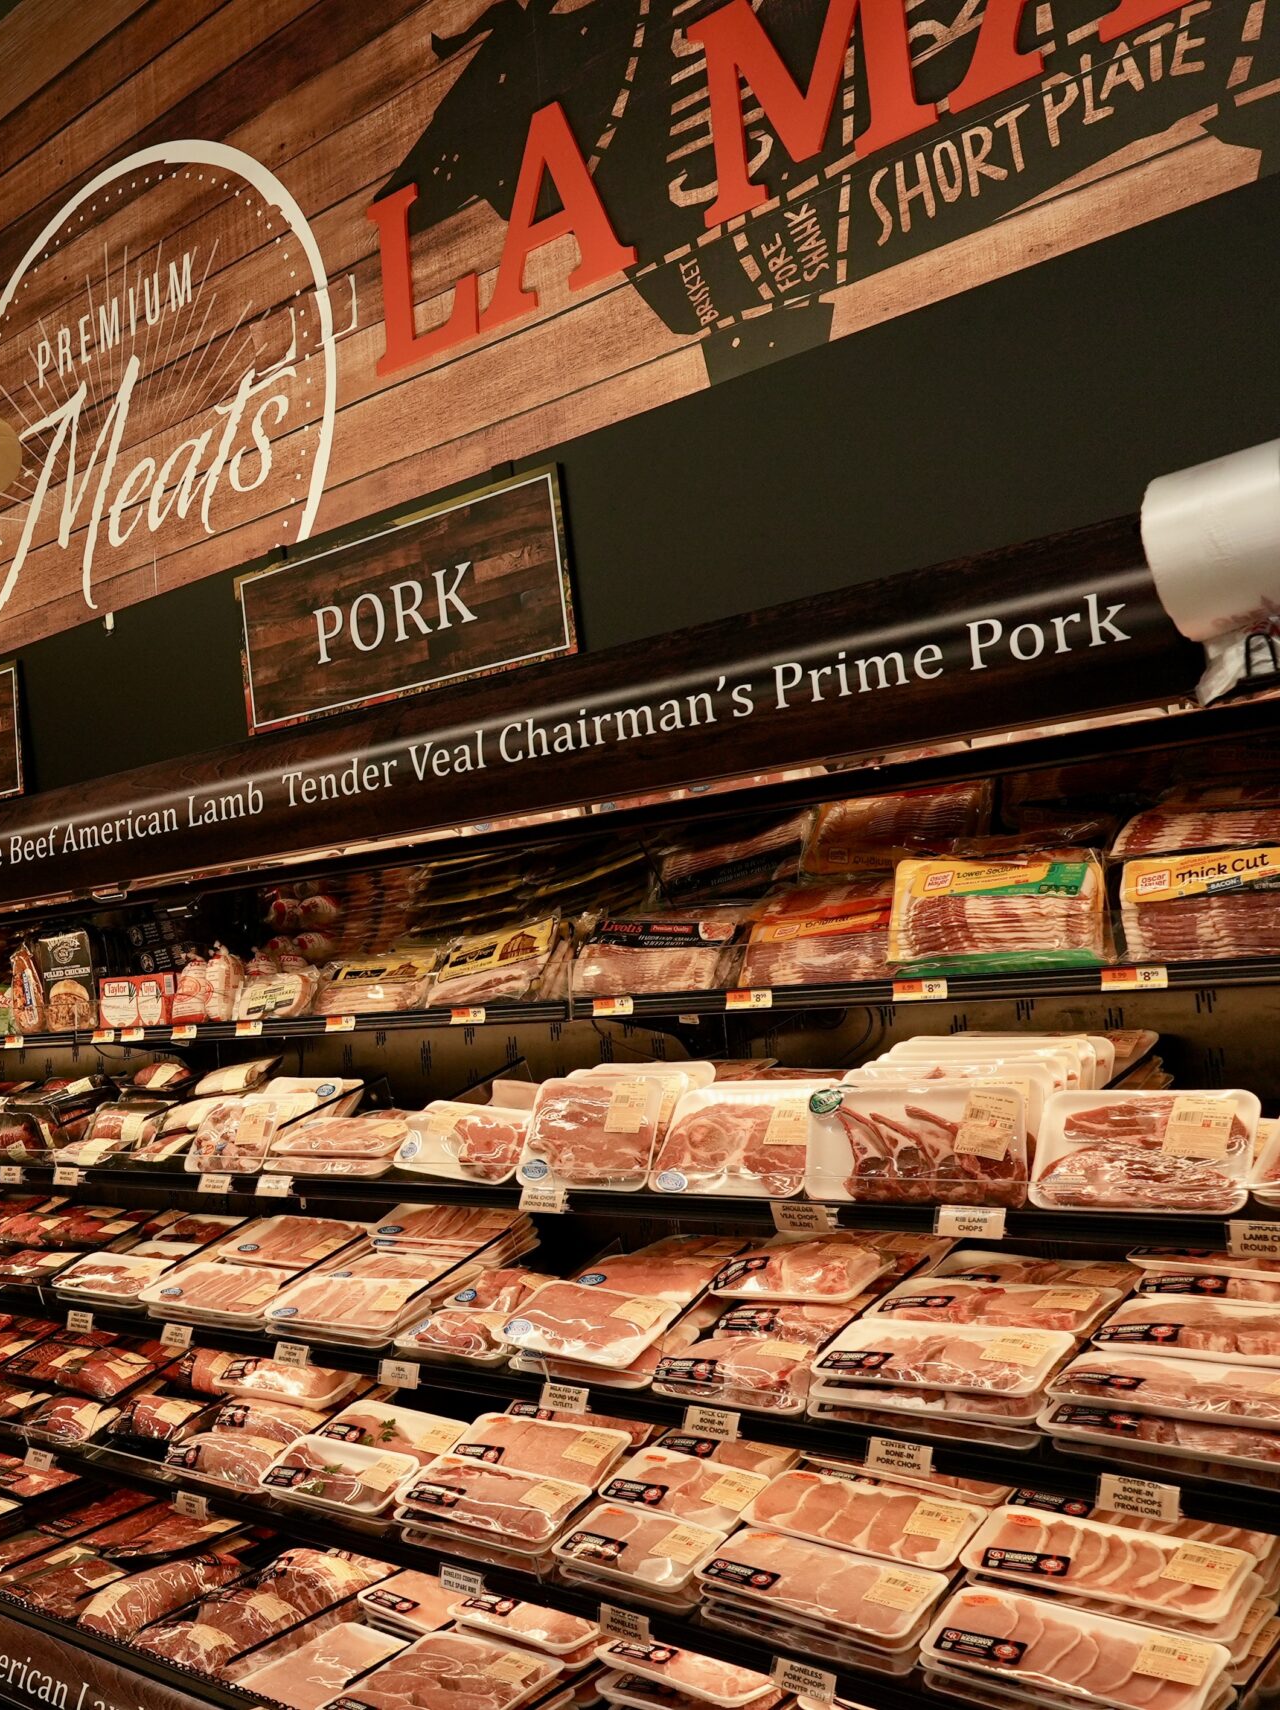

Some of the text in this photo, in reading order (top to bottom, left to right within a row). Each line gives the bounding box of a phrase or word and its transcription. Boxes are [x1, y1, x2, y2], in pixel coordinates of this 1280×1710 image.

[869, 103, 1030, 246] SHORT
[1042, 0, 1211, 147] PLATE
[366, 100, 638, 377] LA
[784, 203, 829, 282] SHANK
[761, 233, 801, 293] FORE
[679, 258, 719, 327] BRISKET
[36, 252, 194, 388] PREMIUM
[313, 561, 477, 665] PORK
[10, 826, 59, 865] Beef
[61, 808, 179, 853] American
[187, 781, 264, 827] Lamb
[282, 757, 398, 807] Tender
[409, 729, 487, 782] Veal
[498, 675, 755, 763] Chairman's
[772, 642, 945, 710] Prime
[966, 593, 1131, 672] Pork
[956, 870, 985, 878] Lower
[1176, 853, 1269, 884] Thick Cut
[1210, 879, 1236, 890] BACON
[107, 983, 126, 995] Taylor
[797, 1213, 819, 1221] CHOPS
[958, 1224, 983, 1232] CHOPS
[1243, 1232, 1269, 1241] LAMB
[1240, 1242, 1278, 1252] (ROUND
[699, 1417, 724, 1426] BONE-IN
[691, 1423, 729, 1436] PORK CHOPS
[880, 1440, 921, 1452] CENTER CUT
[885, 1449, 914, 1459] BONE-IN
[876, 1456, 921, 1470] PORK CHOPS
[1117, 1476, 1145, 1487] CENTER
[1122, 1486, 1154, 1497] BONE-IN
[1113, 1493, 1162, 1508] PORK CHOPS
[1114, 1501, 1162, 1517] (FROM LOIN)
[610, 1617, 638, 1631] BONELESS
[606, 1623, 642, 1641] PORK CHOPS
[789, 1664, 823, 1680] BONELESS
[781, 1680, 808, 1693] (CENTER
[783, 1671, 826, 1690] PORK CHOPS
